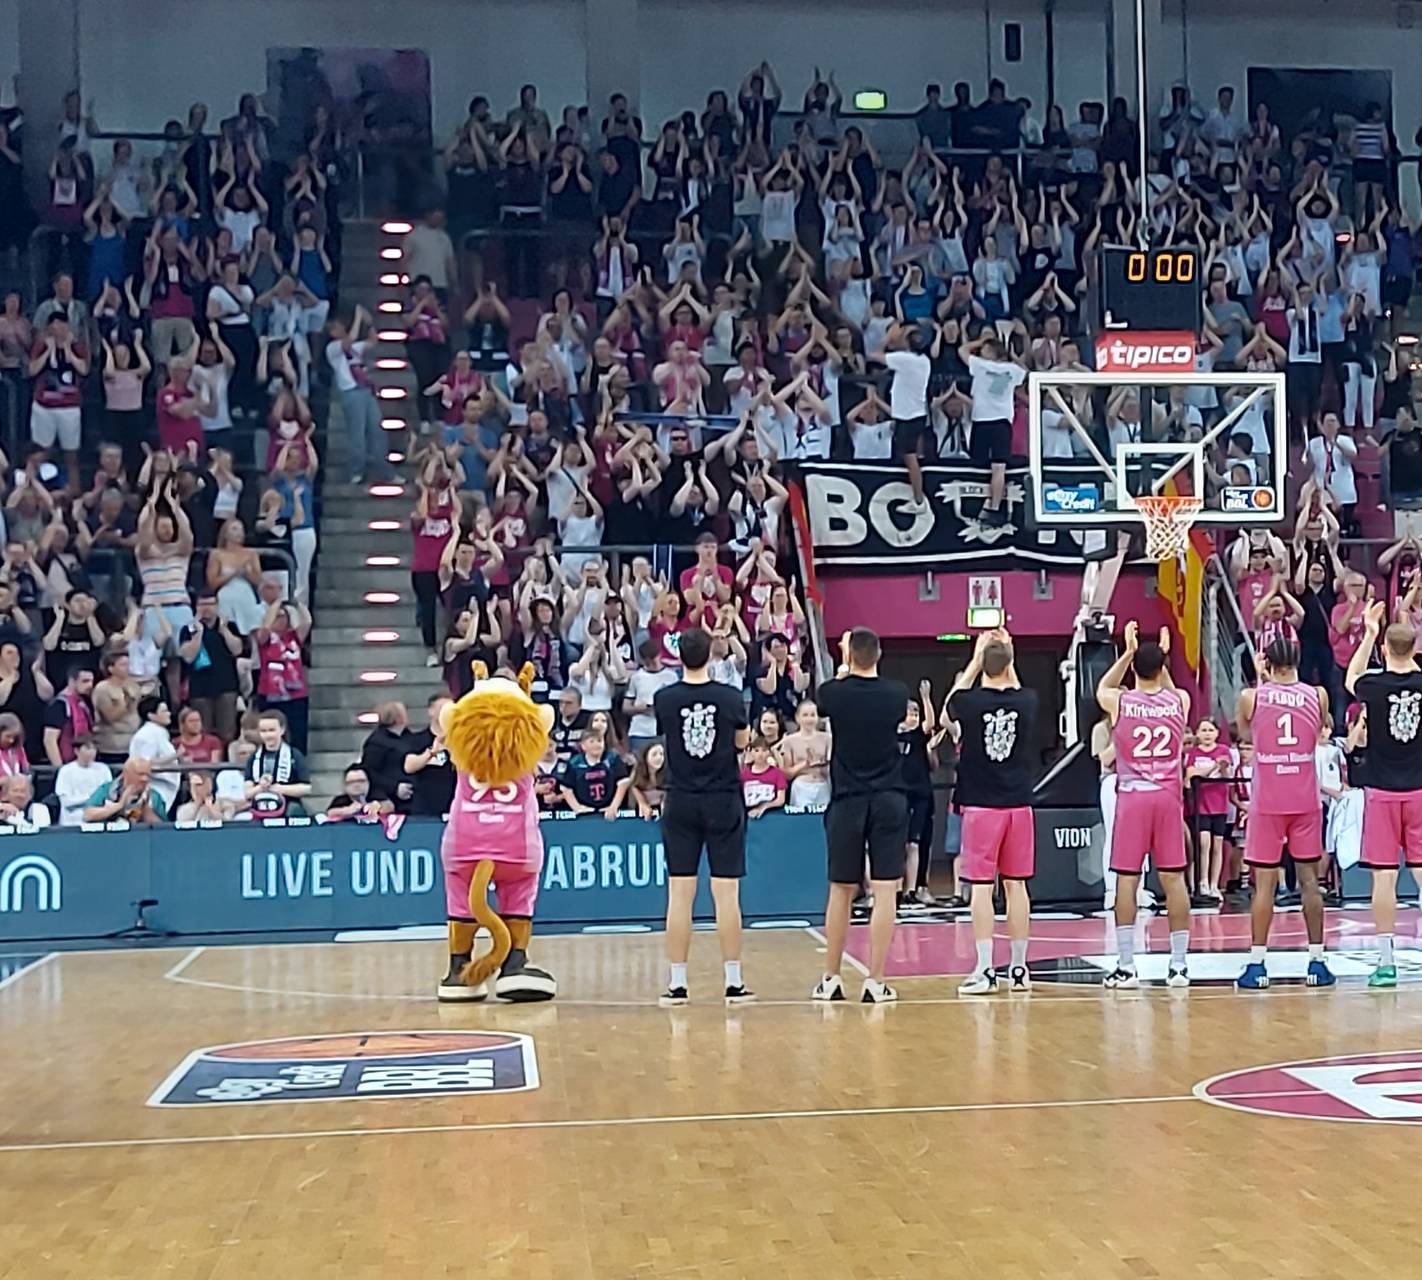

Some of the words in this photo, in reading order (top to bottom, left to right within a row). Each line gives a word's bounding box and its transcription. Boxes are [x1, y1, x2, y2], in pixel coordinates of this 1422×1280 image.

[1110, 339, 1192, 369] tipico
[1125, 702, 1179, 718] Kirkwood
[1133, 725, 1172, 758] 22
[1277, 712, 1298, 746] 1
[1054, 827, 1092, 848] VION
[241, 851, 334, 899] LIVE
[351, 849, 435, 896] UND
